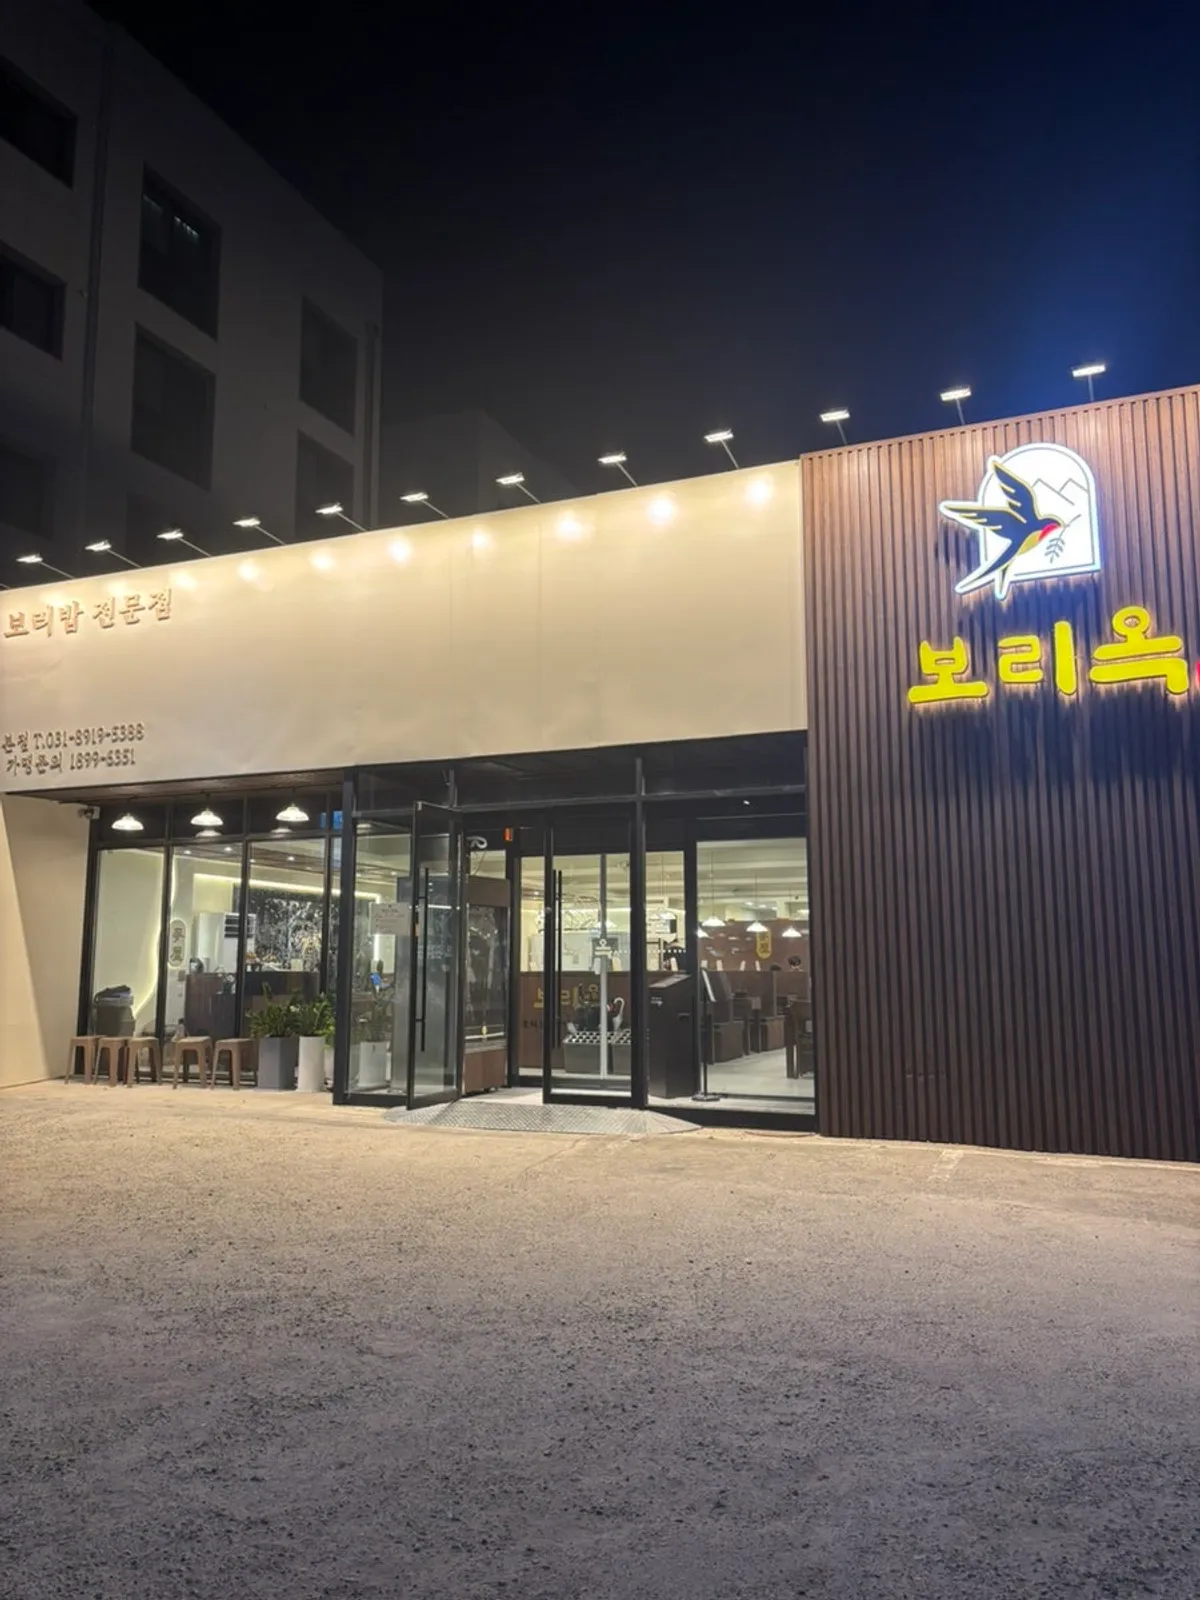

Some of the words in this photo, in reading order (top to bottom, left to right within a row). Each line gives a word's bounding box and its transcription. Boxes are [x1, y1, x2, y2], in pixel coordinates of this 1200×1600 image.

[4, 600, 84, 638] 보리밥
[92, 588, 172, 629] 전문점
[908, 605, 1189, 704] 보리옥
[2, 731, 29, 753] 본점
[6, 752, 63, 777] 가맹문의
